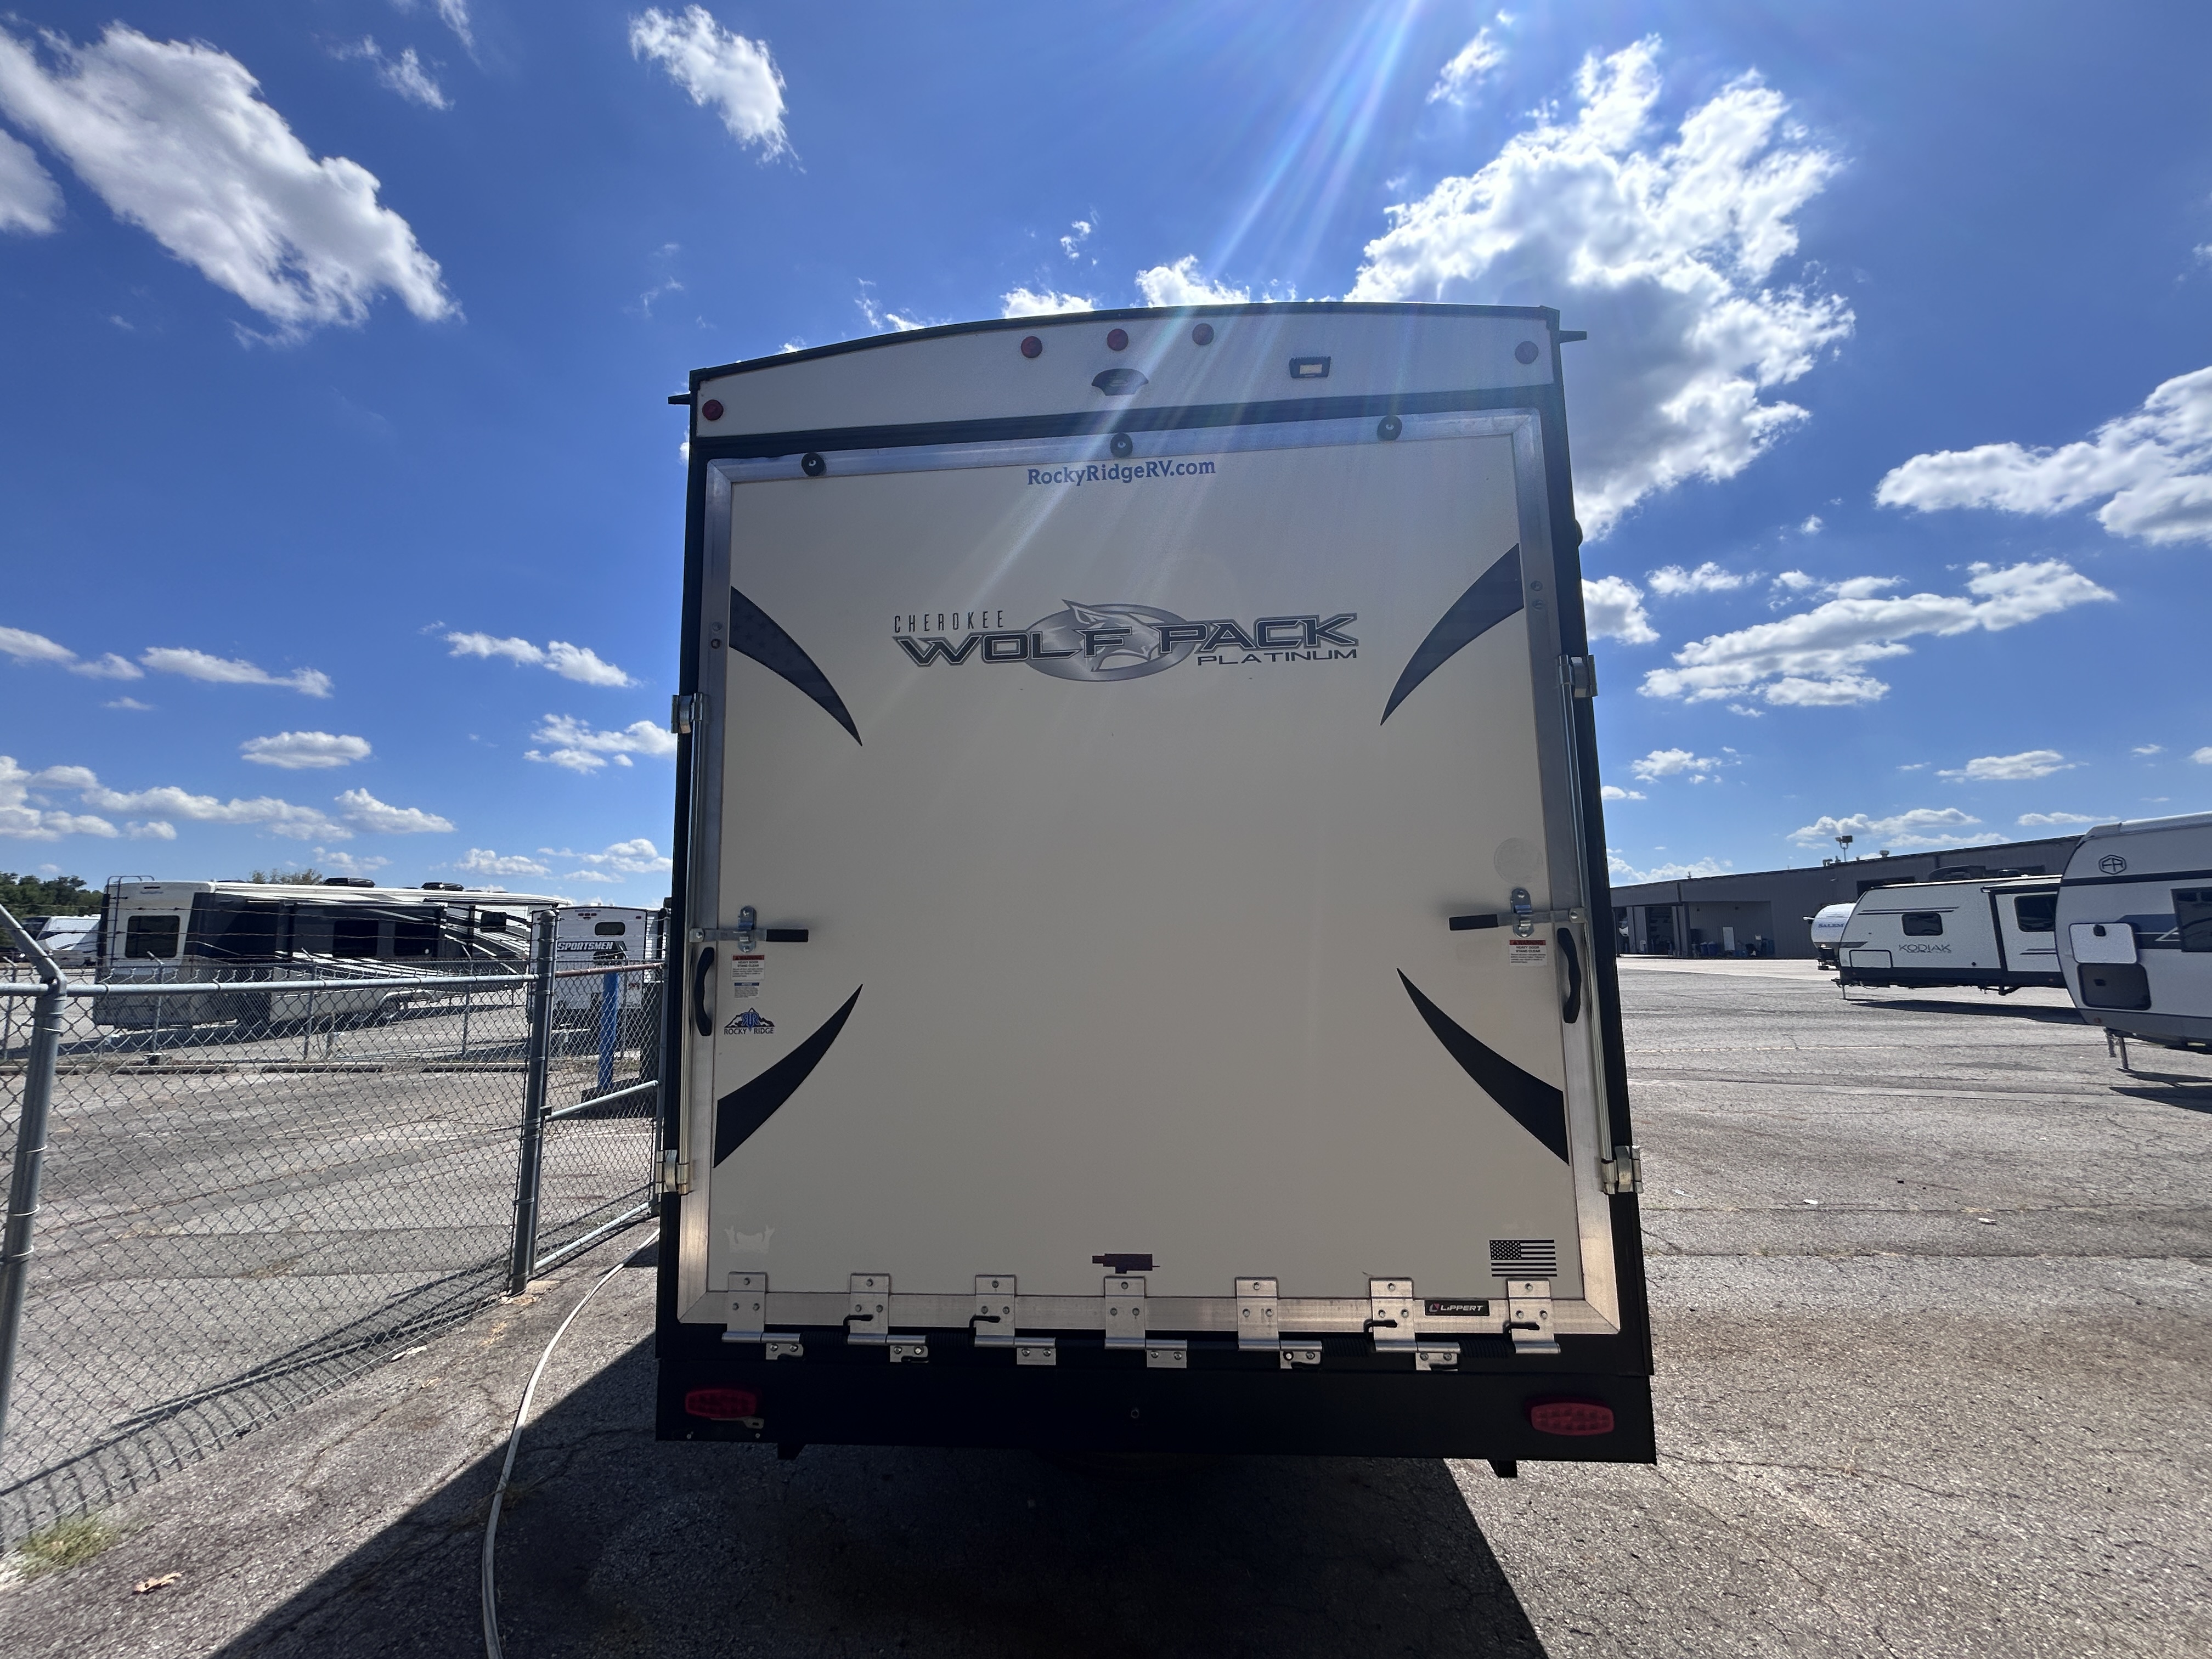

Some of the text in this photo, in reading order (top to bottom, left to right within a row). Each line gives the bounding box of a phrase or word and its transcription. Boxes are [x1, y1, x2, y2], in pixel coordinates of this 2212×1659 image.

[1028, 460, 1216, 486] RockyRidgeRV.com
[894, 610, 1003, 633] CHEROKEE
[892, 613, 1359, 667] WOLF PACK
[1198, 649, 1357, 666] PLATINUM
[557, 941, 614, 951] SPORTSMEN
[1898, 944, 1951, 953] KODIAK
